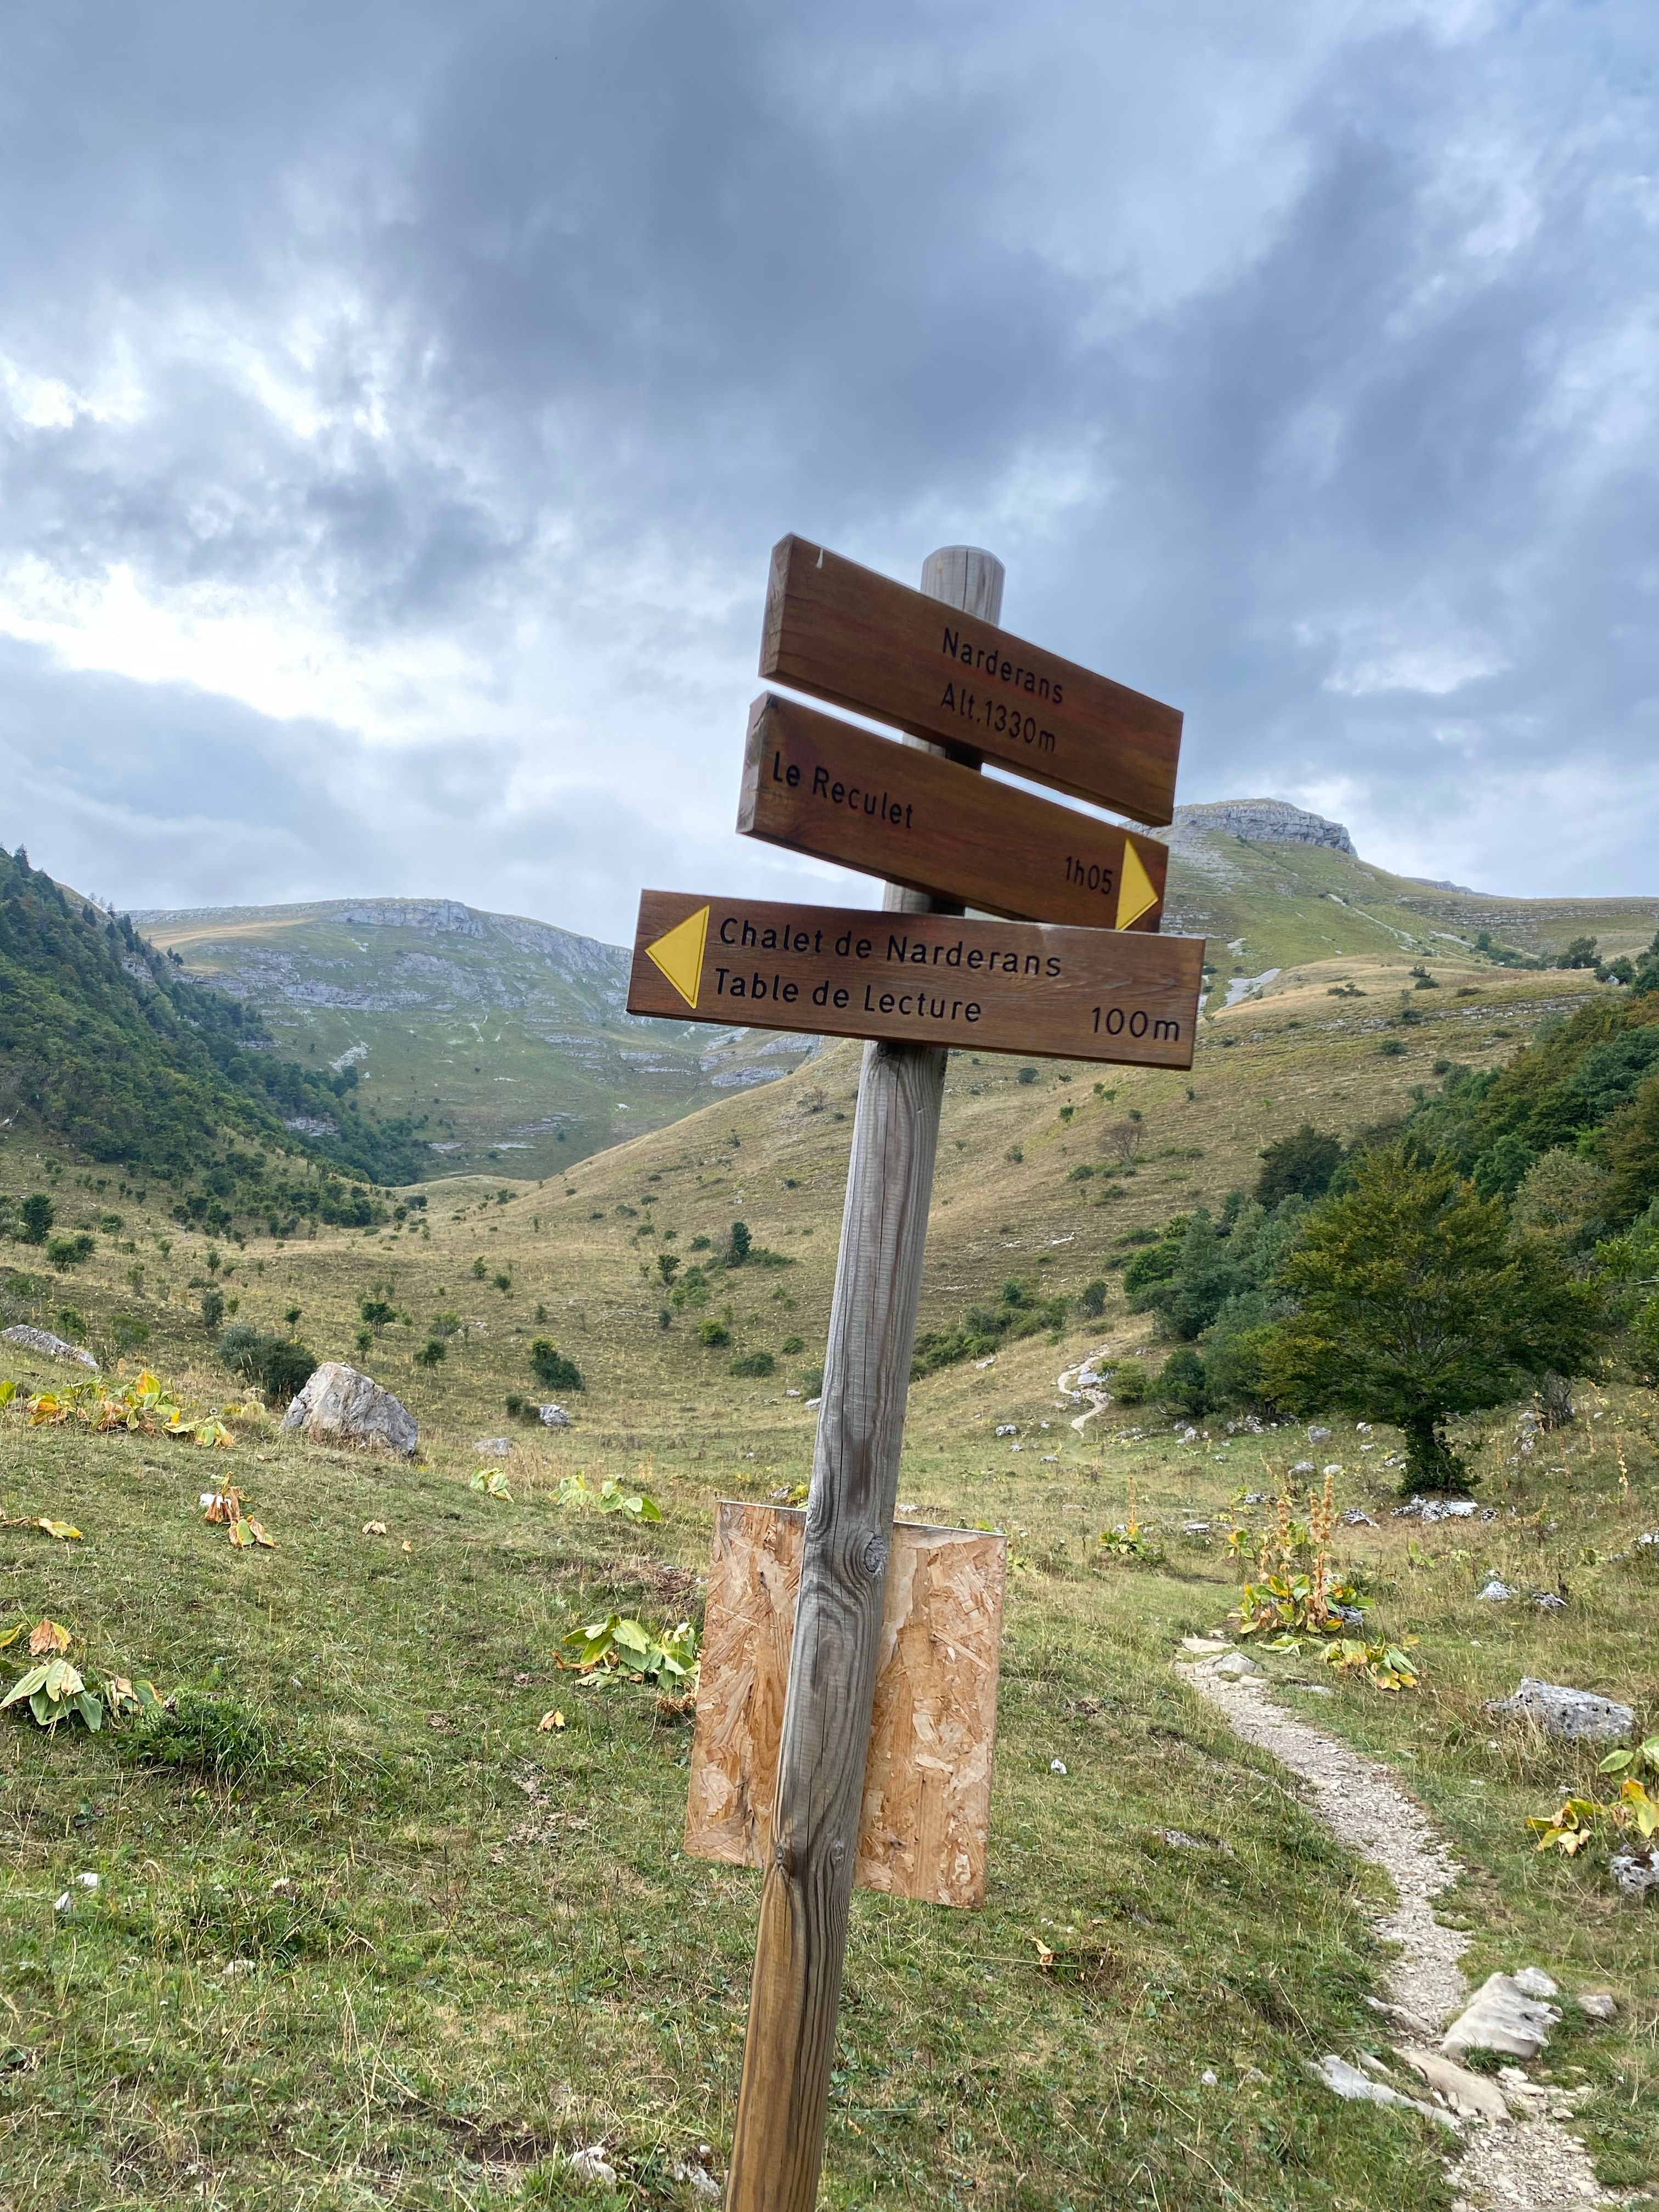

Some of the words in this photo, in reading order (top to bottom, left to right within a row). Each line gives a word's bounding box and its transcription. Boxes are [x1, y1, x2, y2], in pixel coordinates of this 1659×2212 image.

[942, 627, 1064, 704] Narderans
[941, 683, 1056, 753] Alt.1330m
[773, 752, 800, 787] Le
[812, 768, 913, 829] Reculet
[1065, 857, 1112, 895] 1h05
[719, 917, 823, 954] Chalet
[835, 929, 872, 958] de
[887, 935, 1062, 977] Narderans
[716, 968, 798, 1003] Table
[812, 979, 849, 1008] de
[865, 985, 981, 1022] Lecture
[1091, 1007, 1180, 1042] 100m
